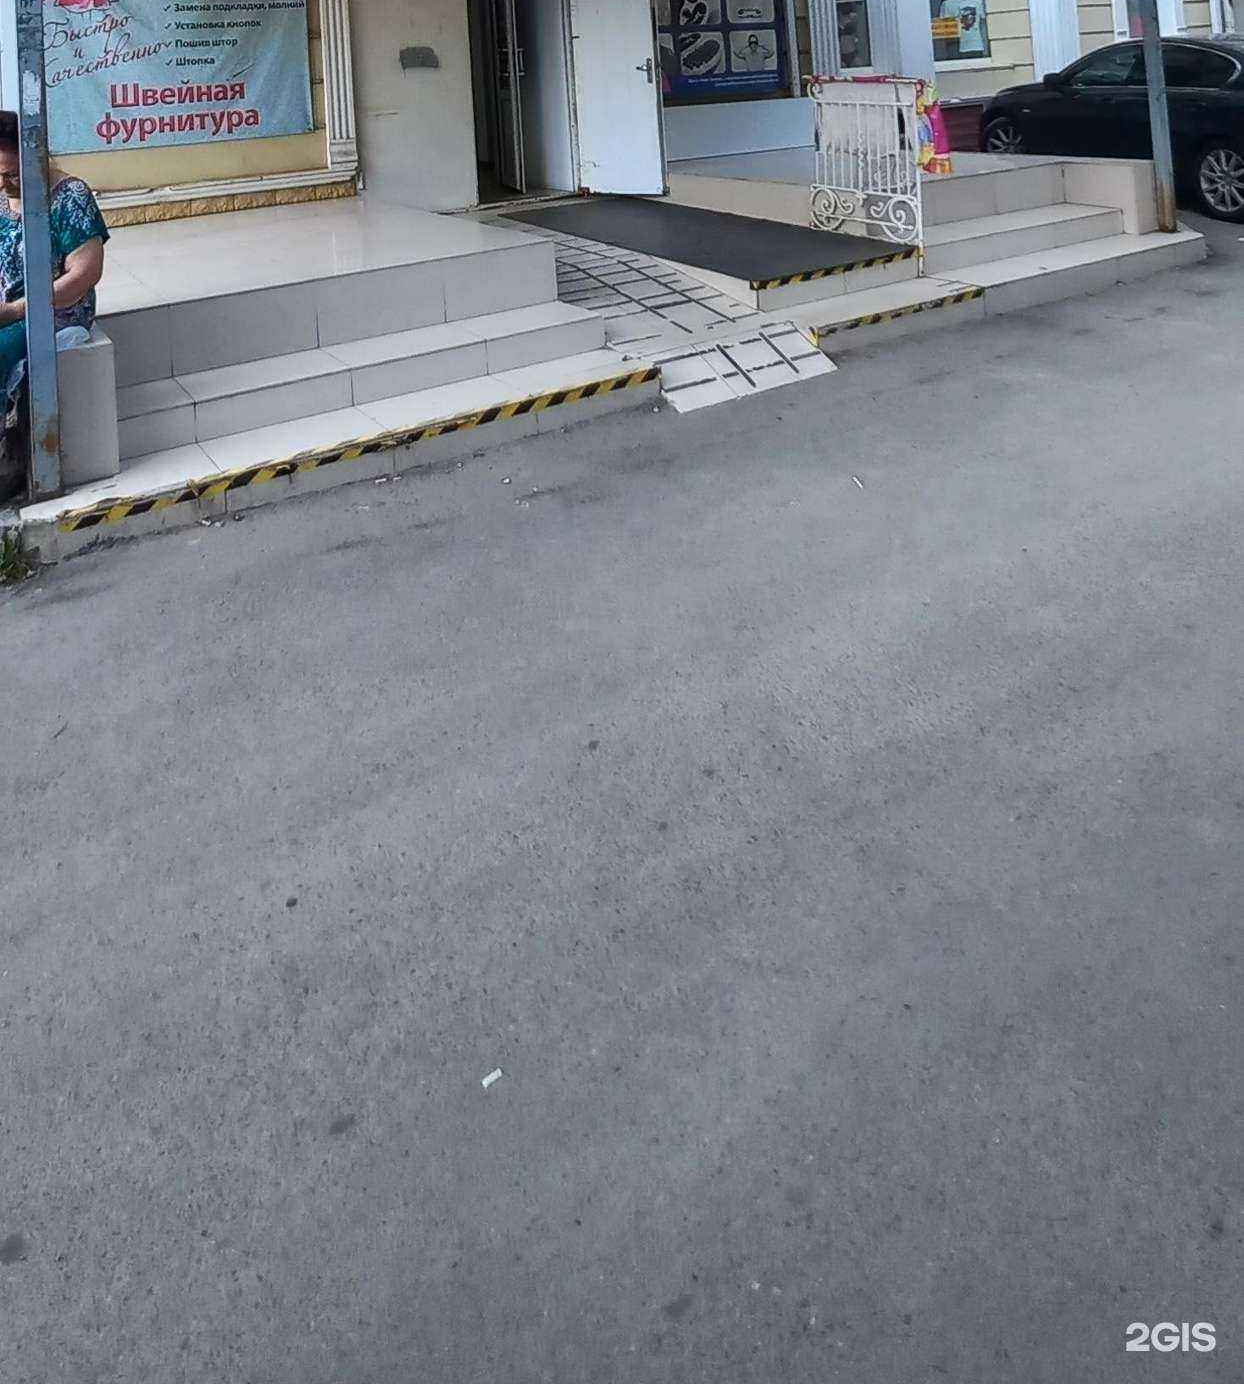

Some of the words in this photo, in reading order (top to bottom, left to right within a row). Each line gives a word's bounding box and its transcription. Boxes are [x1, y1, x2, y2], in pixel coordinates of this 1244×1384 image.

[174, 2, 211, 12] Замена
[174, 20, 225, 31] Установка
[226, 19, 262, 29] кнопок
[175, 38, 211, 48] Пошив
[212, 37, 238, 48] штор
[175, 56, 215, 66] Штопка
[110, 79, 246, 108] Швейная
[96, 108, 260, 145] фурнитура
